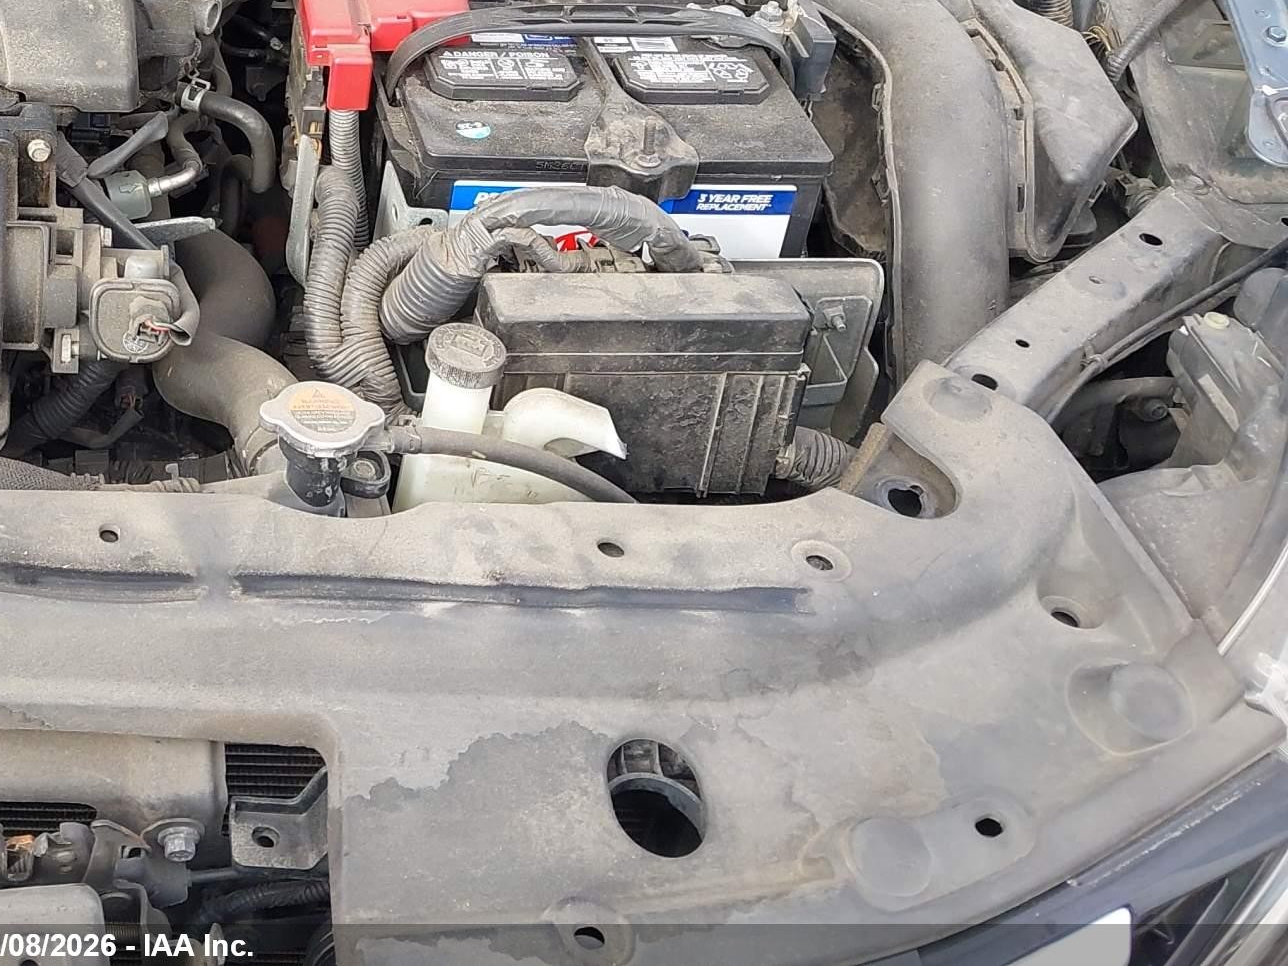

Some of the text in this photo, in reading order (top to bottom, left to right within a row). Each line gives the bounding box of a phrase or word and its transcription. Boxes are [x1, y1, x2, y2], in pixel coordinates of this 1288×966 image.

[697, 194, 774, 203] 3 YEAR FREE
